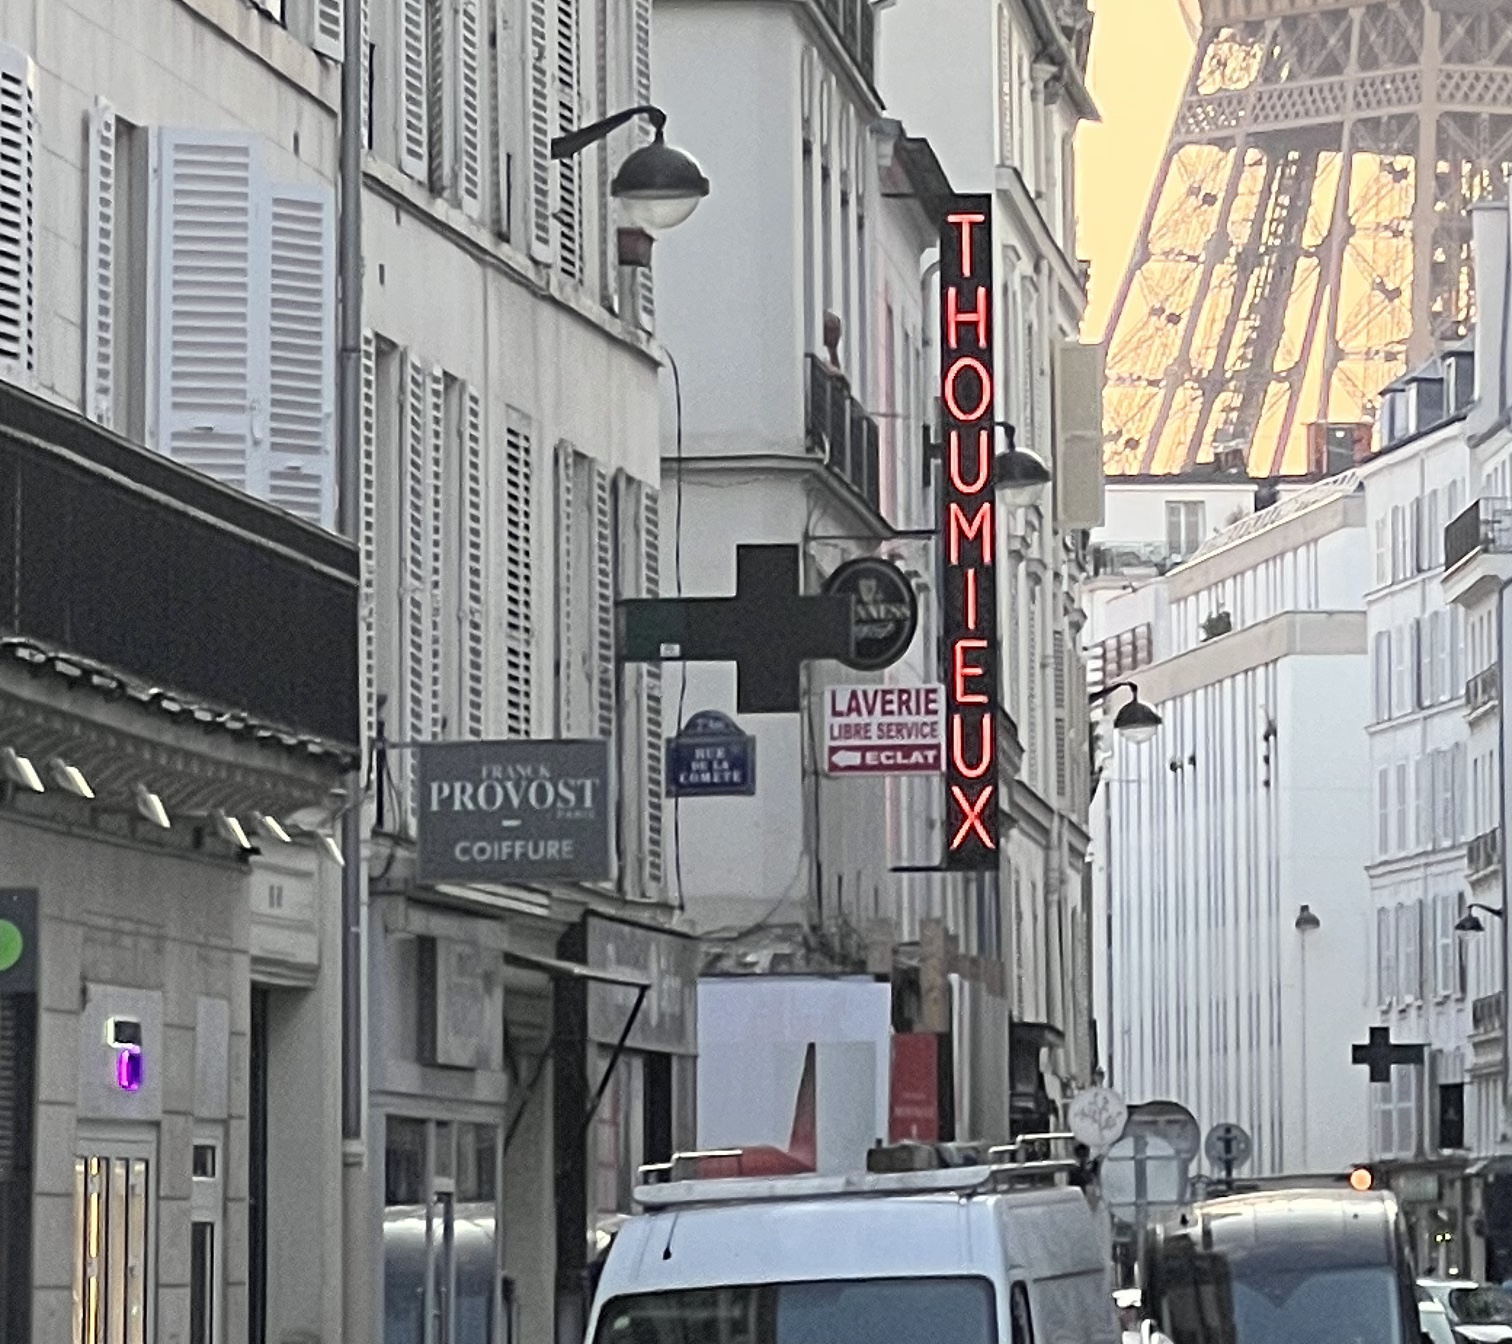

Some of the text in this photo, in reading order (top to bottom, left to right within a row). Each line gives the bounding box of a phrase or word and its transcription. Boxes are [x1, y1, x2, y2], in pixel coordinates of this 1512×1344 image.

[944, 213, 996, 850] THOUMIEUX
[831, 688, 939, 717] LAVERIE
[830, 721, 939, 741] LIBRE SERVICE
[694, 747, 725, 759] RUE
[865, 750, 937, 765] ECLAT
[481, 765, 551, 779] FRANCK
[713, 760, 729, 769] LA
[430, 778, 600, 811] PROVOST
[454, 839, 575, 861] COIFFURE
